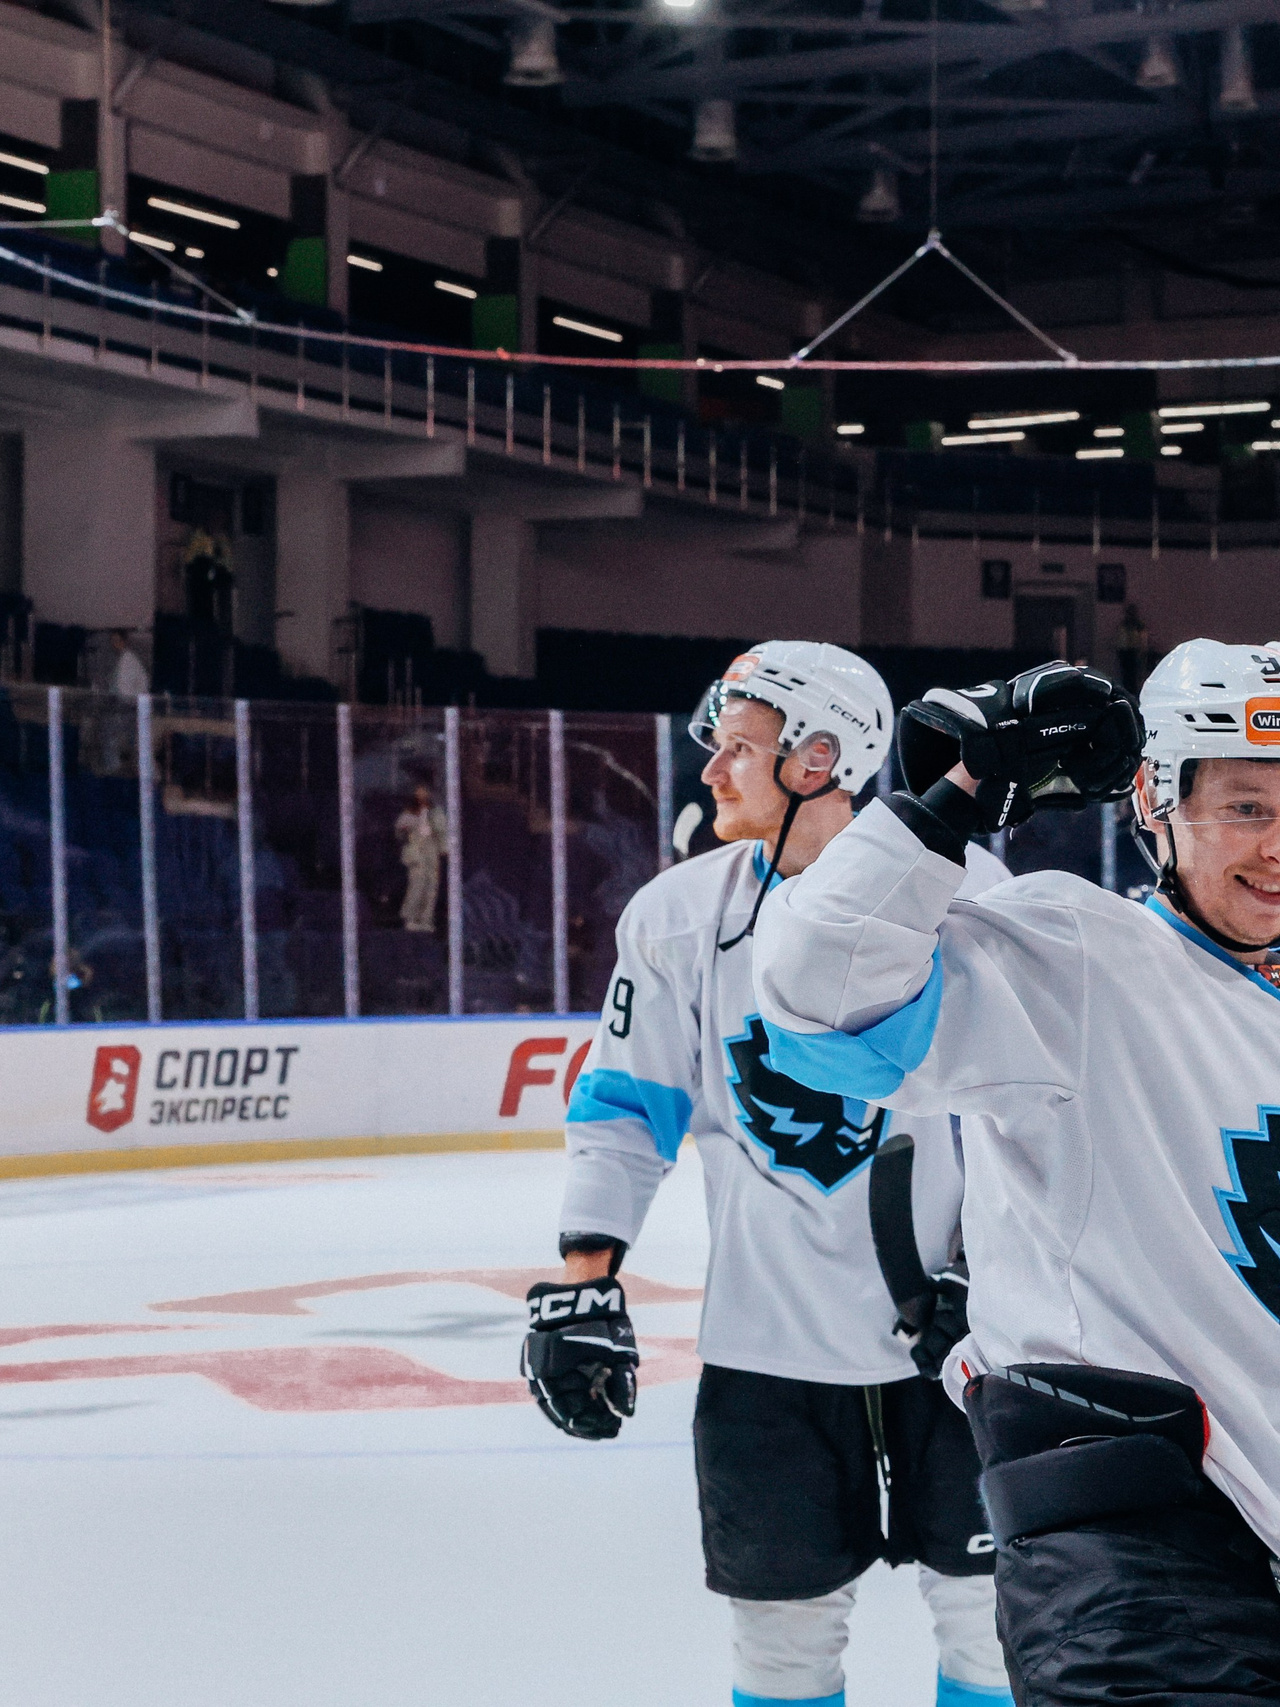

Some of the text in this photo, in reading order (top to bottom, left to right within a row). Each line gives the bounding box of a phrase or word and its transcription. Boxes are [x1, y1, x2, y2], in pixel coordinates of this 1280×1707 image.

[829, 703, 866, 728] CCM
[1039, 723, 1087, 737] TACKS
[998, 781, 1018, 827] CCM
[608, 976, 635, 1040] 9
[155, 1046, 300, 1090] СПОРТ
[150, 1095, 290, 1126] ЭКСПРЕСС
[526, 1287, 621, 1323] CCM
